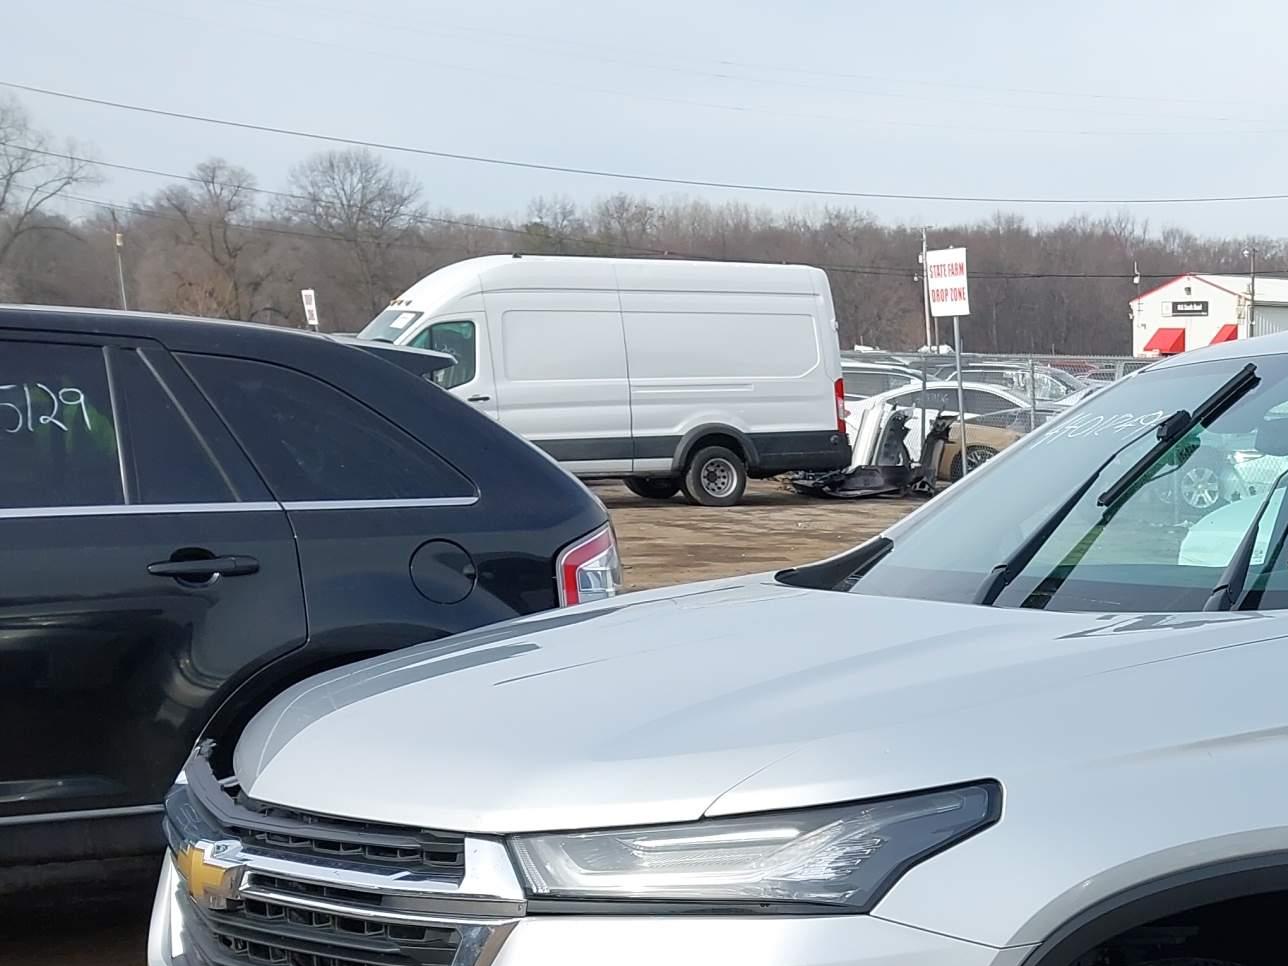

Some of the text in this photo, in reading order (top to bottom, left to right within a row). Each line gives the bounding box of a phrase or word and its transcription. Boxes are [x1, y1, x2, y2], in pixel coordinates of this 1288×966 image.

[930, 262, 965, 278] STATE FARM
[932, 287, 966, 302] DROP ZONE
[0, 383, 92, 433] 5129
